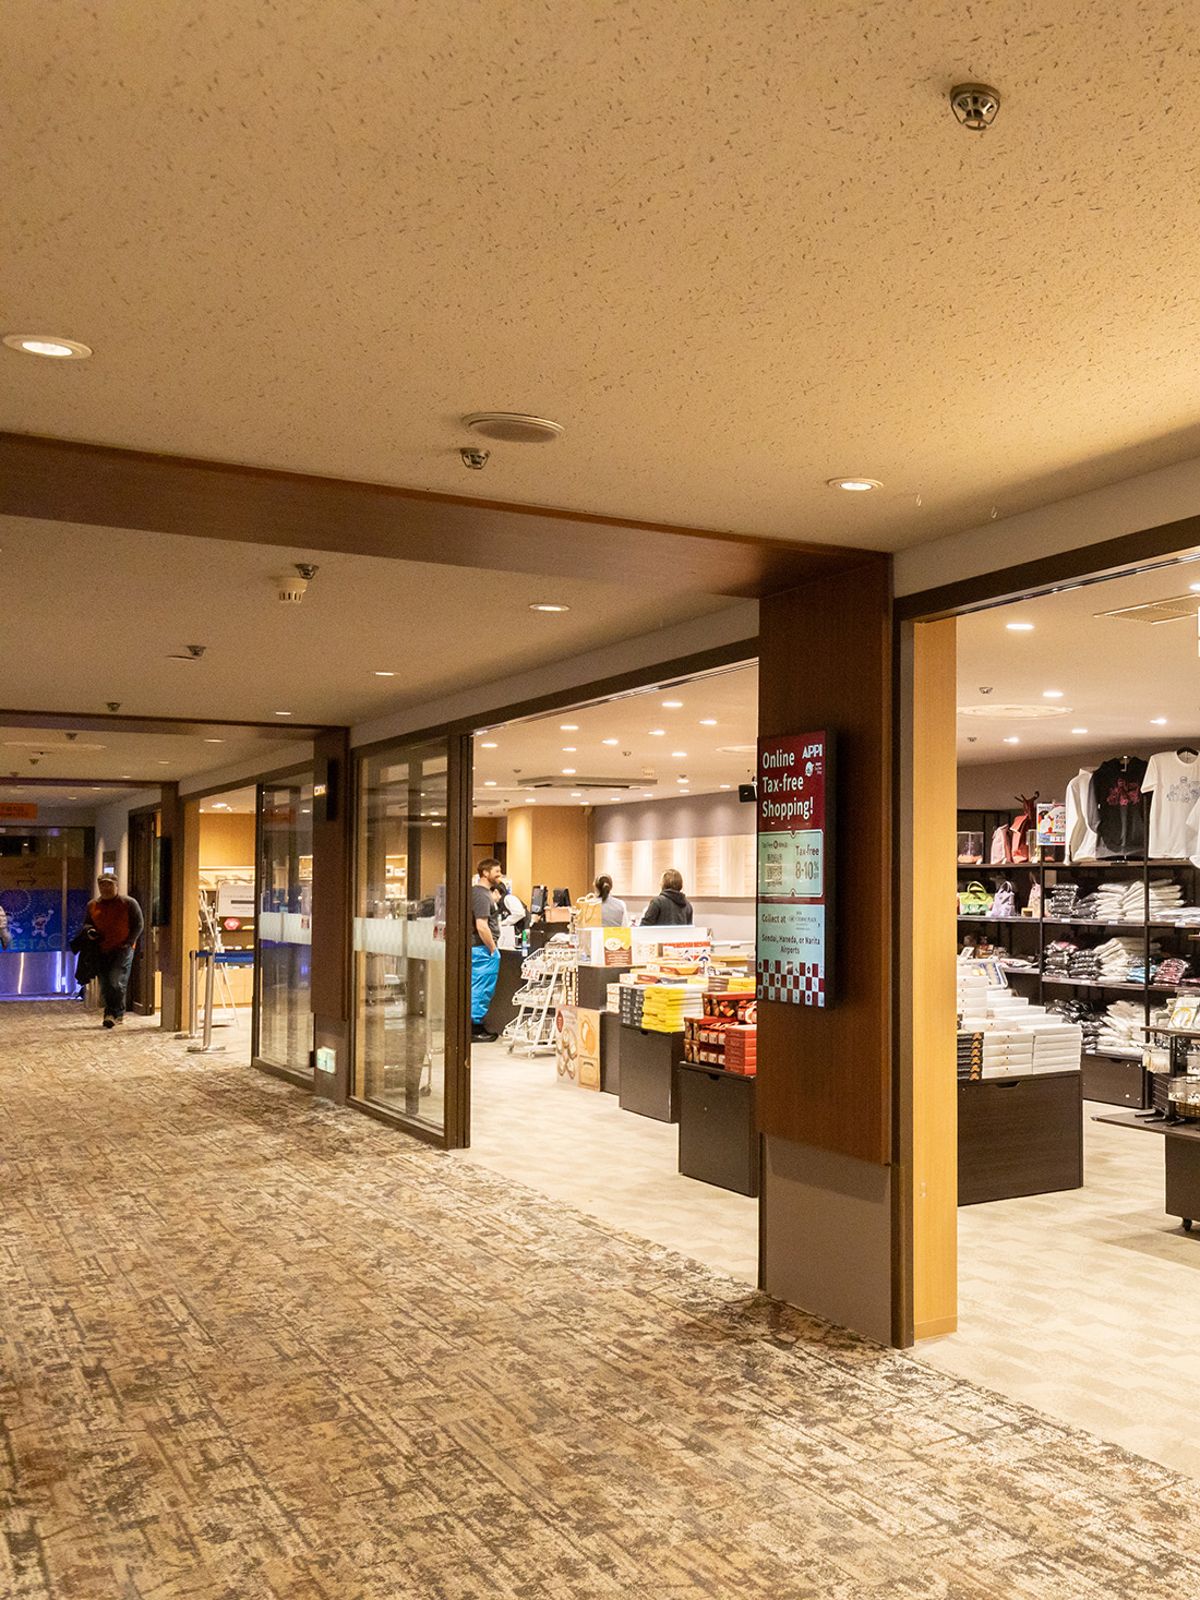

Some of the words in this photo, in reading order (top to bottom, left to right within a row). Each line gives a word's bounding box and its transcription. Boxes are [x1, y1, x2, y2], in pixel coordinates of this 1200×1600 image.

[762, 749, 795, 769] Online
[802, 744, 823, 759] APPI
[762, 773, 804, 793] Tax-free
[762, 796, 814, 820] Shopping!
[796, 844, 820, 856] Tax-free
